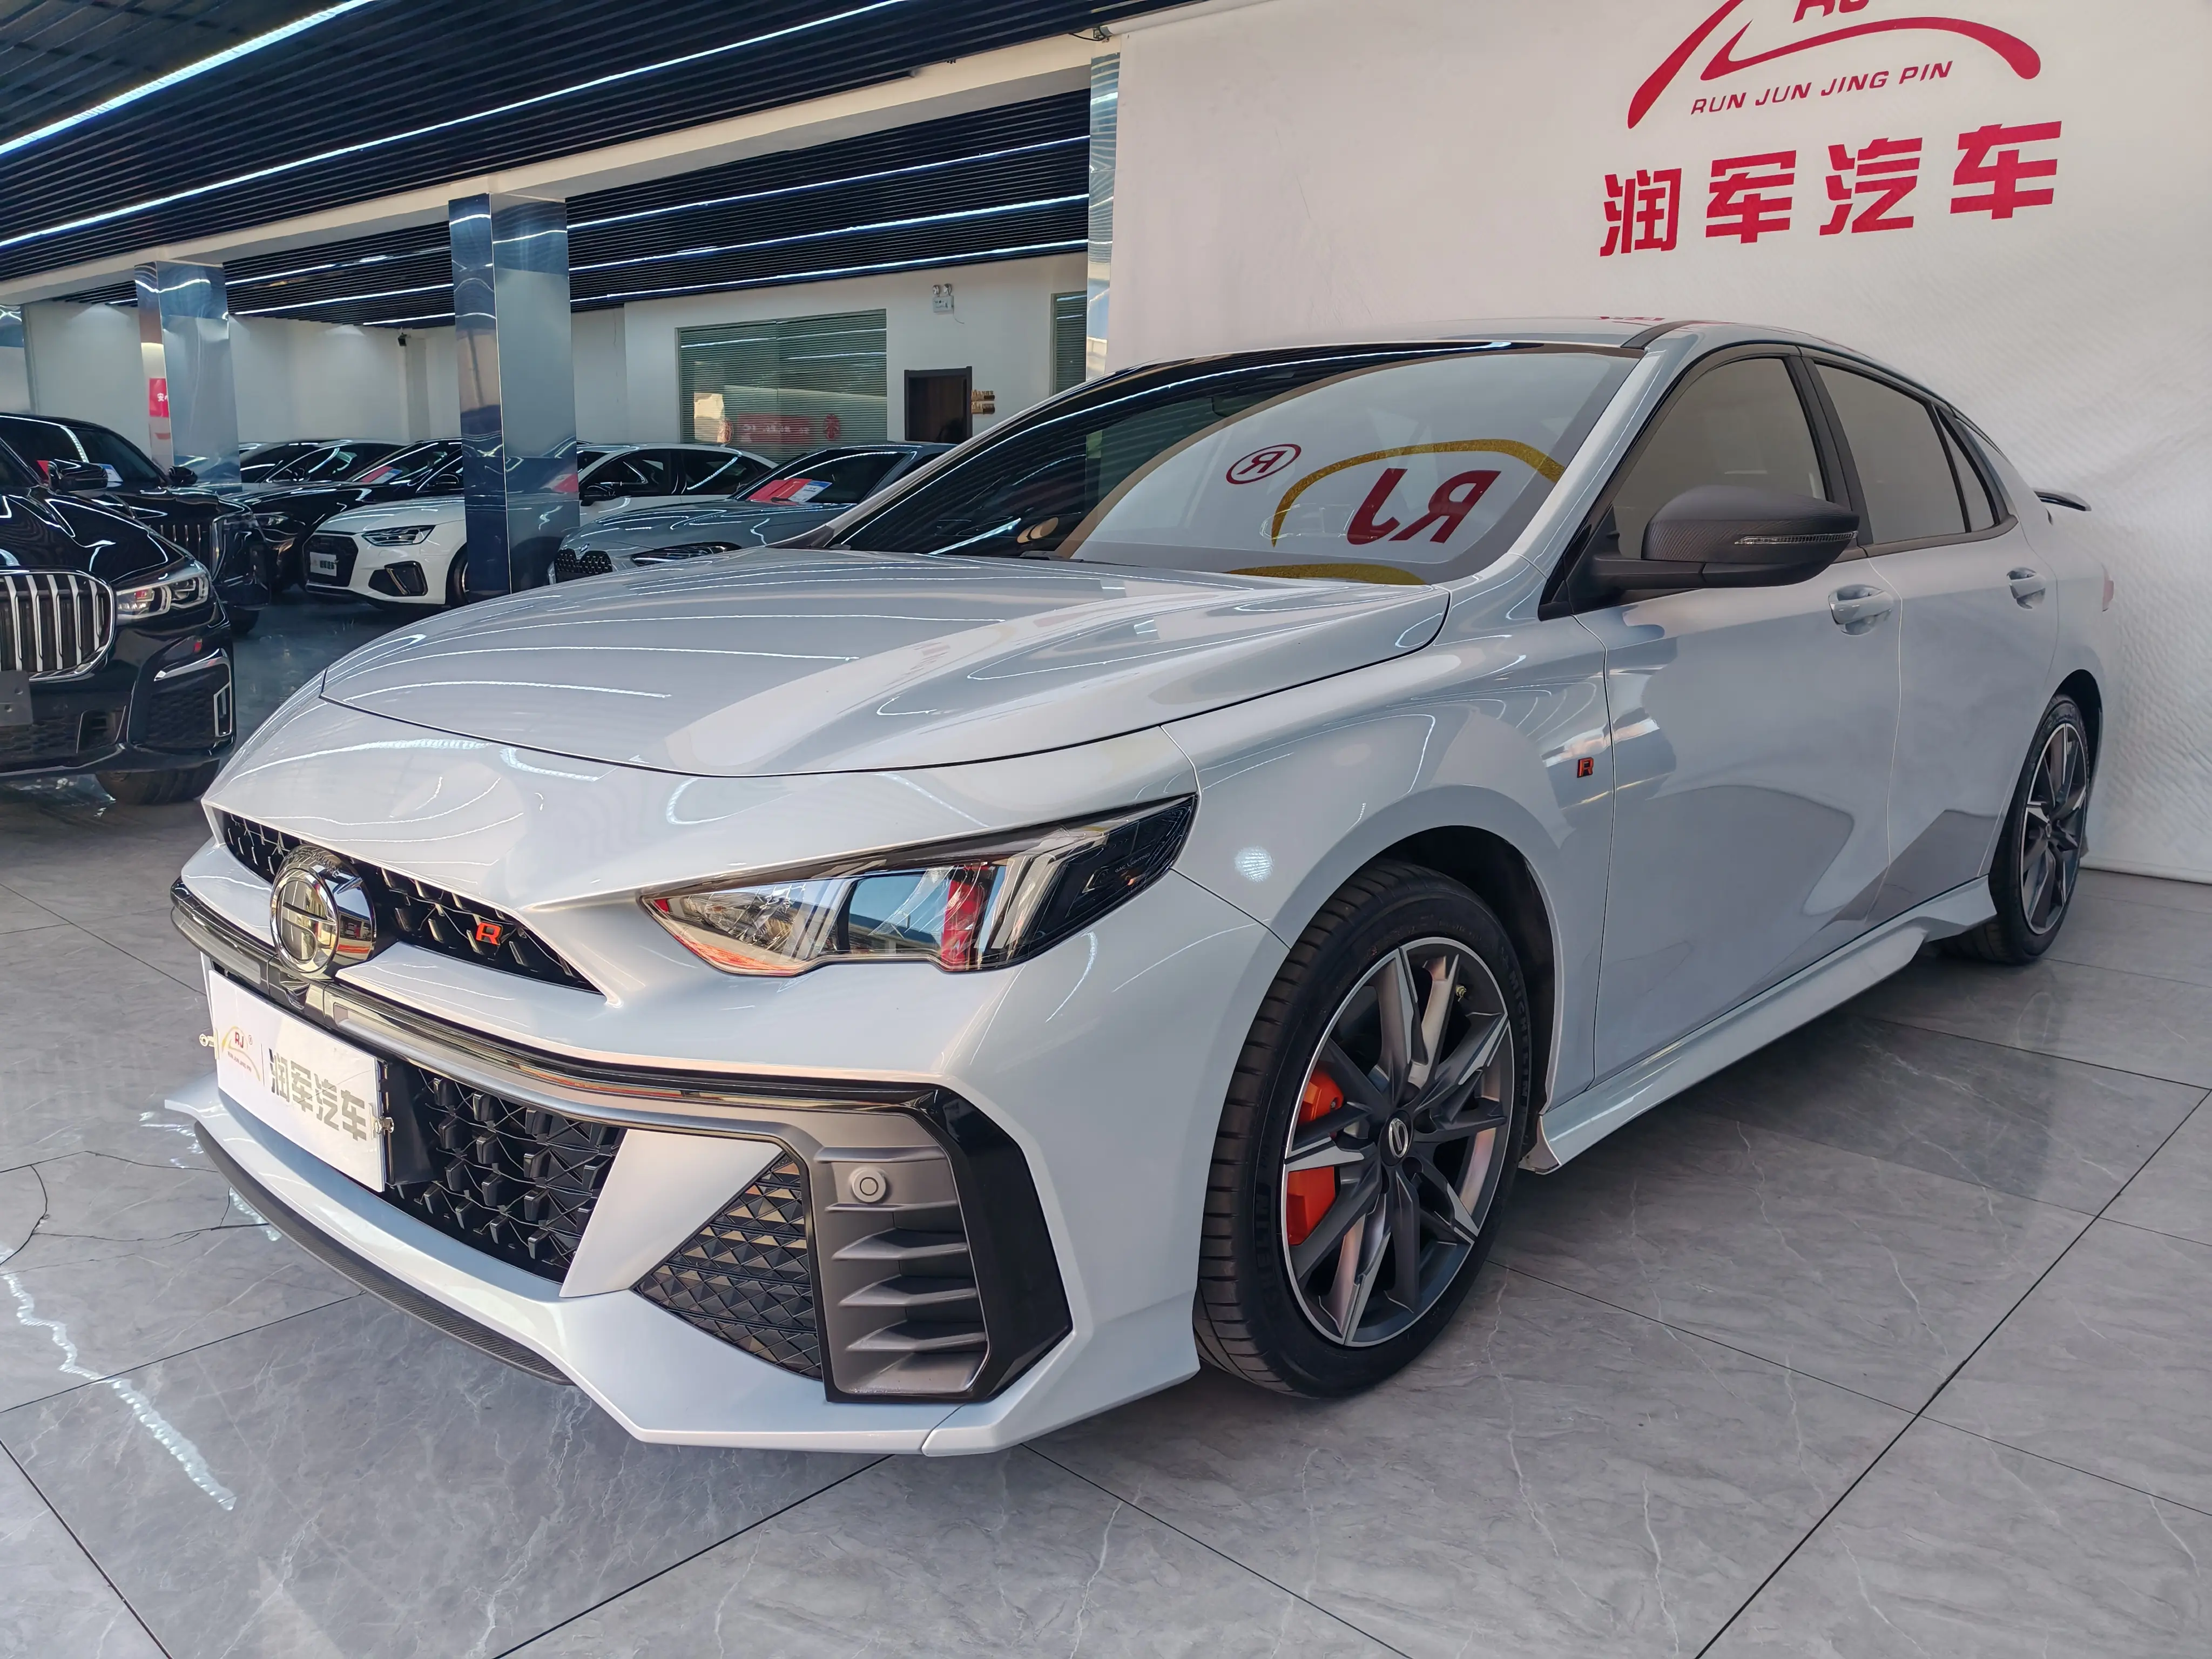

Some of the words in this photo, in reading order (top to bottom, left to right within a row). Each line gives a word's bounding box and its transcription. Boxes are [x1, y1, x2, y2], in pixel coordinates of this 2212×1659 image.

[1691, 92, 1746, 114] RUN
[1755, 82, 1812, 106] JUN
[1820, 70, 1889, 97] JING
[1898, 60, 1953, 85] PIN
[1600, 121, 2062, 257] 润军汽车
[1577, 757, 1594, 778] R
[1115, 865, 1126, 873] GAC
[476, 922, 502, 946] R
[235, 1031, 244, 1049] RJ
[268, 1048, 367, 1142] 润军汽车
